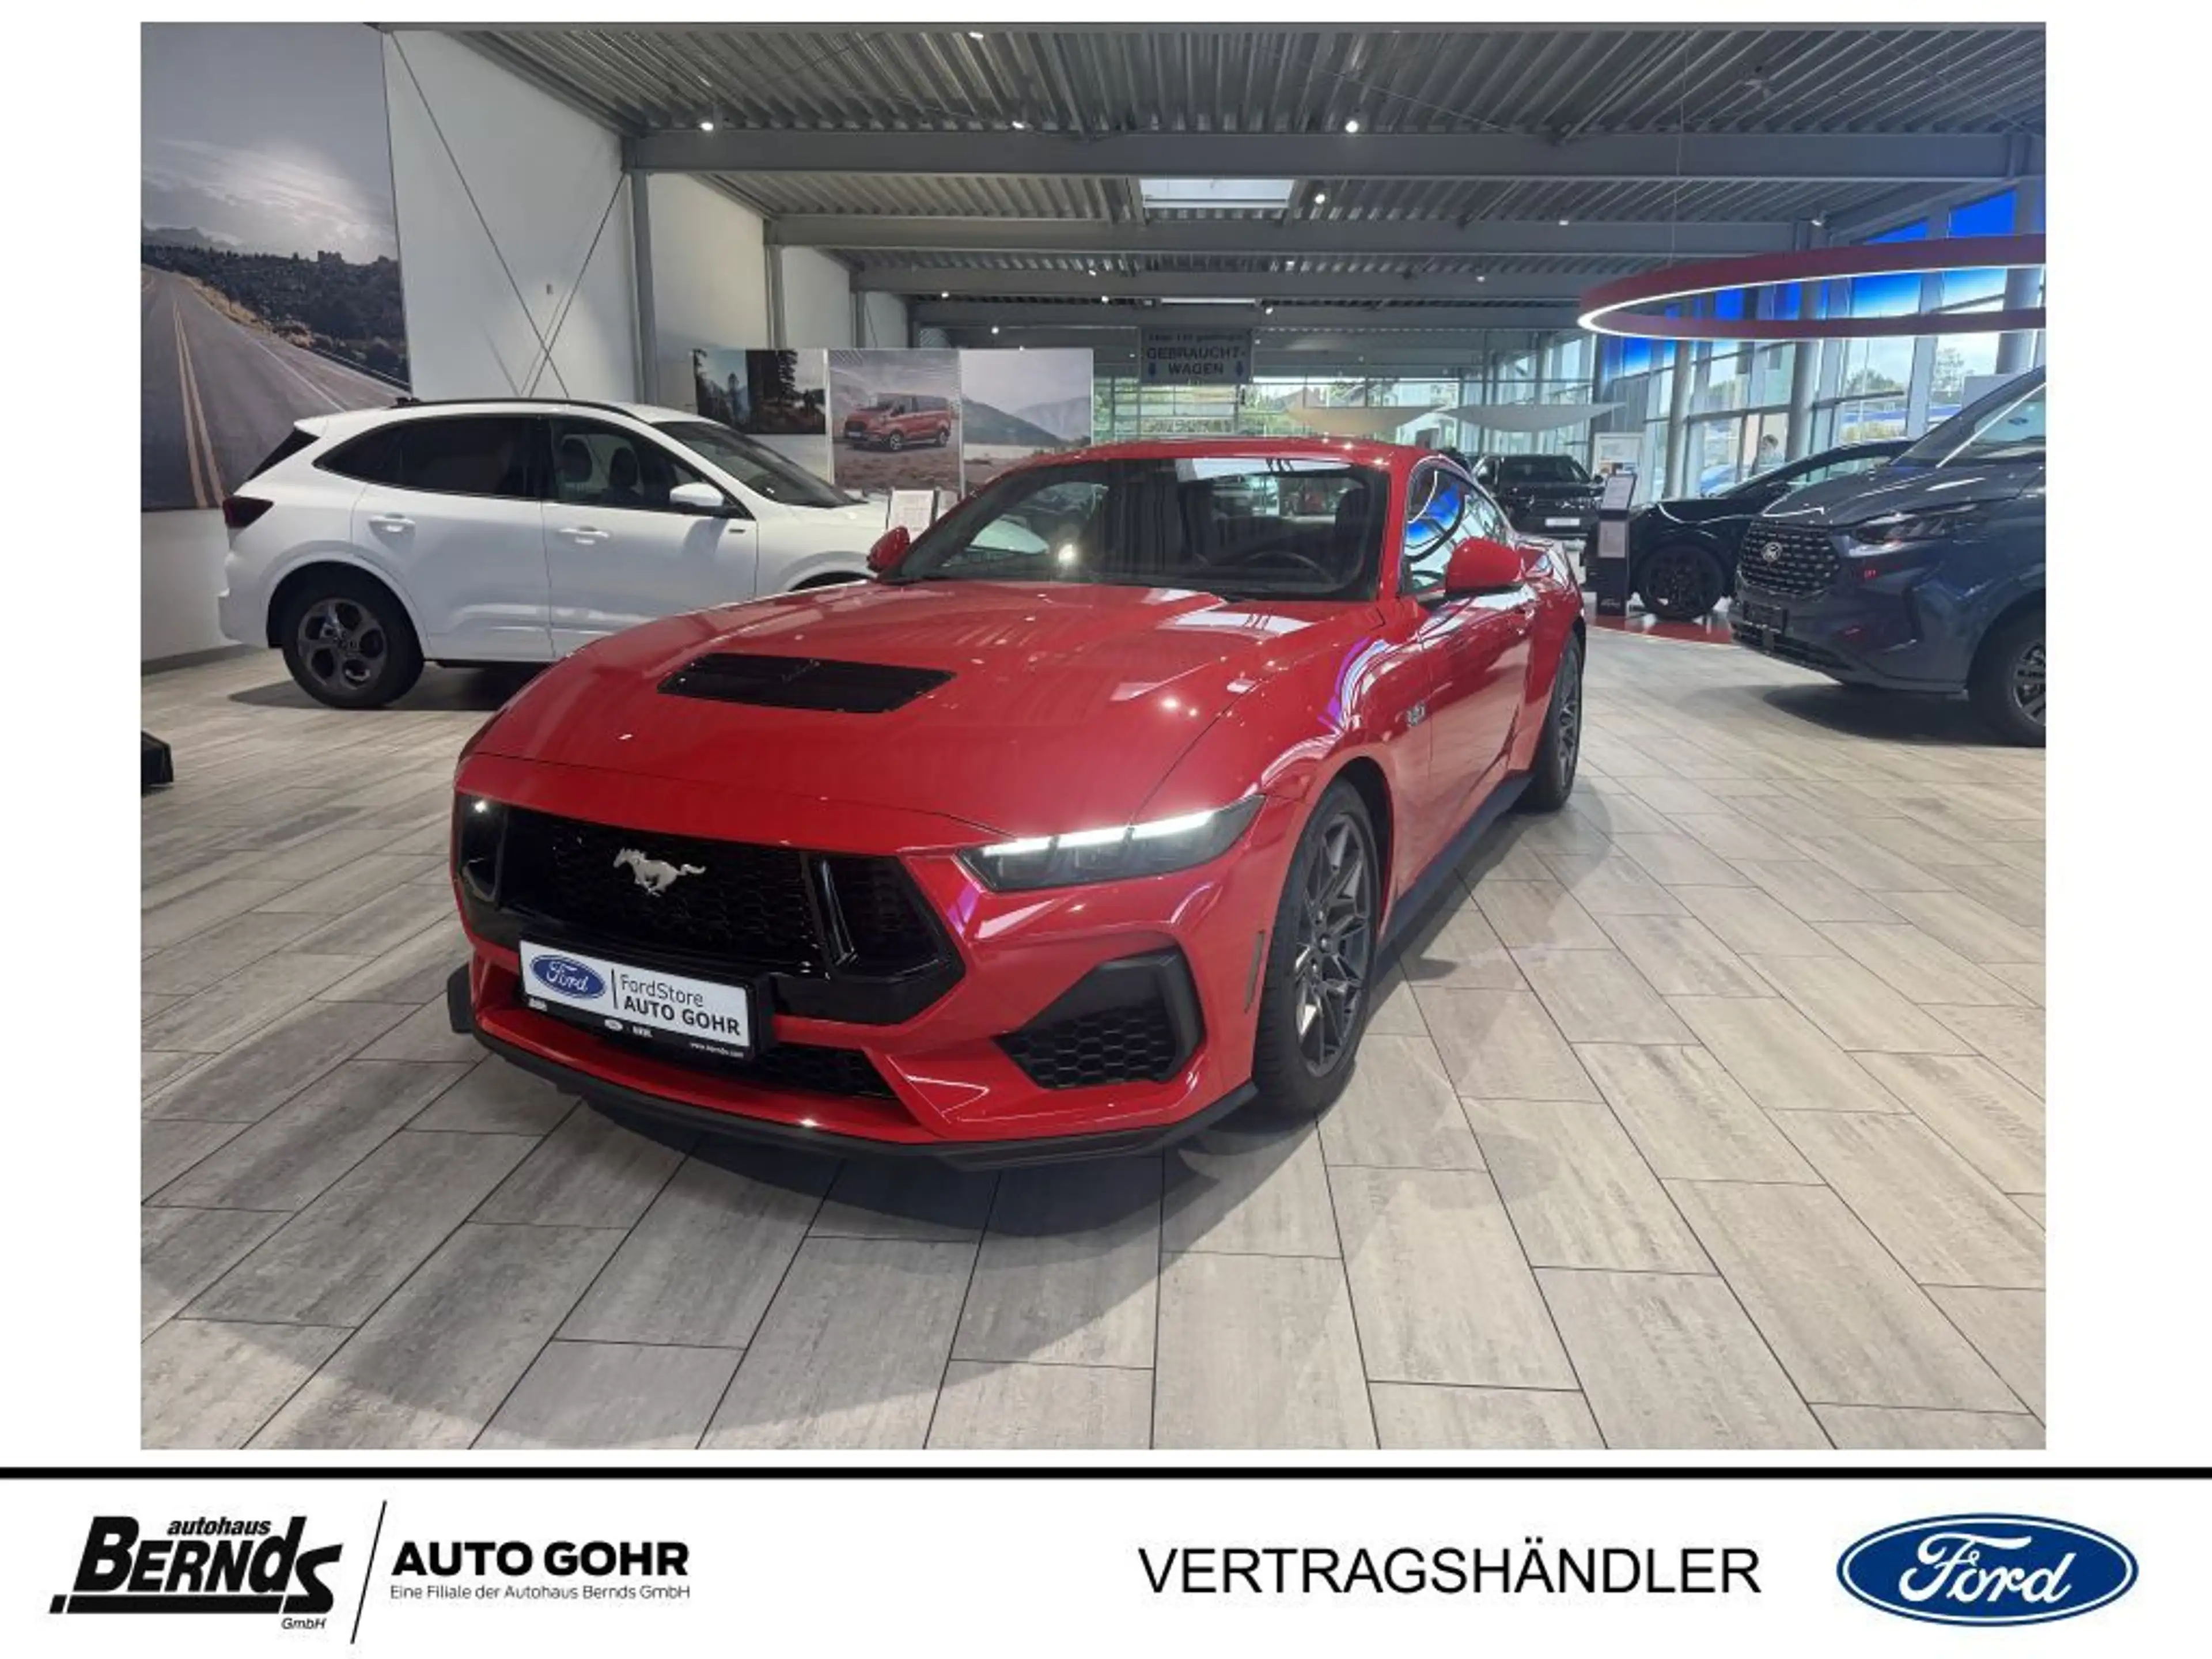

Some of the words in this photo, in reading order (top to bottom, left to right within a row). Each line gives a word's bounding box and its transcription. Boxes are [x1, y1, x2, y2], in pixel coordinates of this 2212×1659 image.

[1146, 346, 1246, 360] GEBRAUCHT-
[1168, 362, 1224, 375] WAGEN
[545, 960, 589, 993] Ford
[620, 974, 704, 1007] FordStore
[623, 995, 675, 1021] AUTO
[681, 1010, 741, 1037] GOHR
